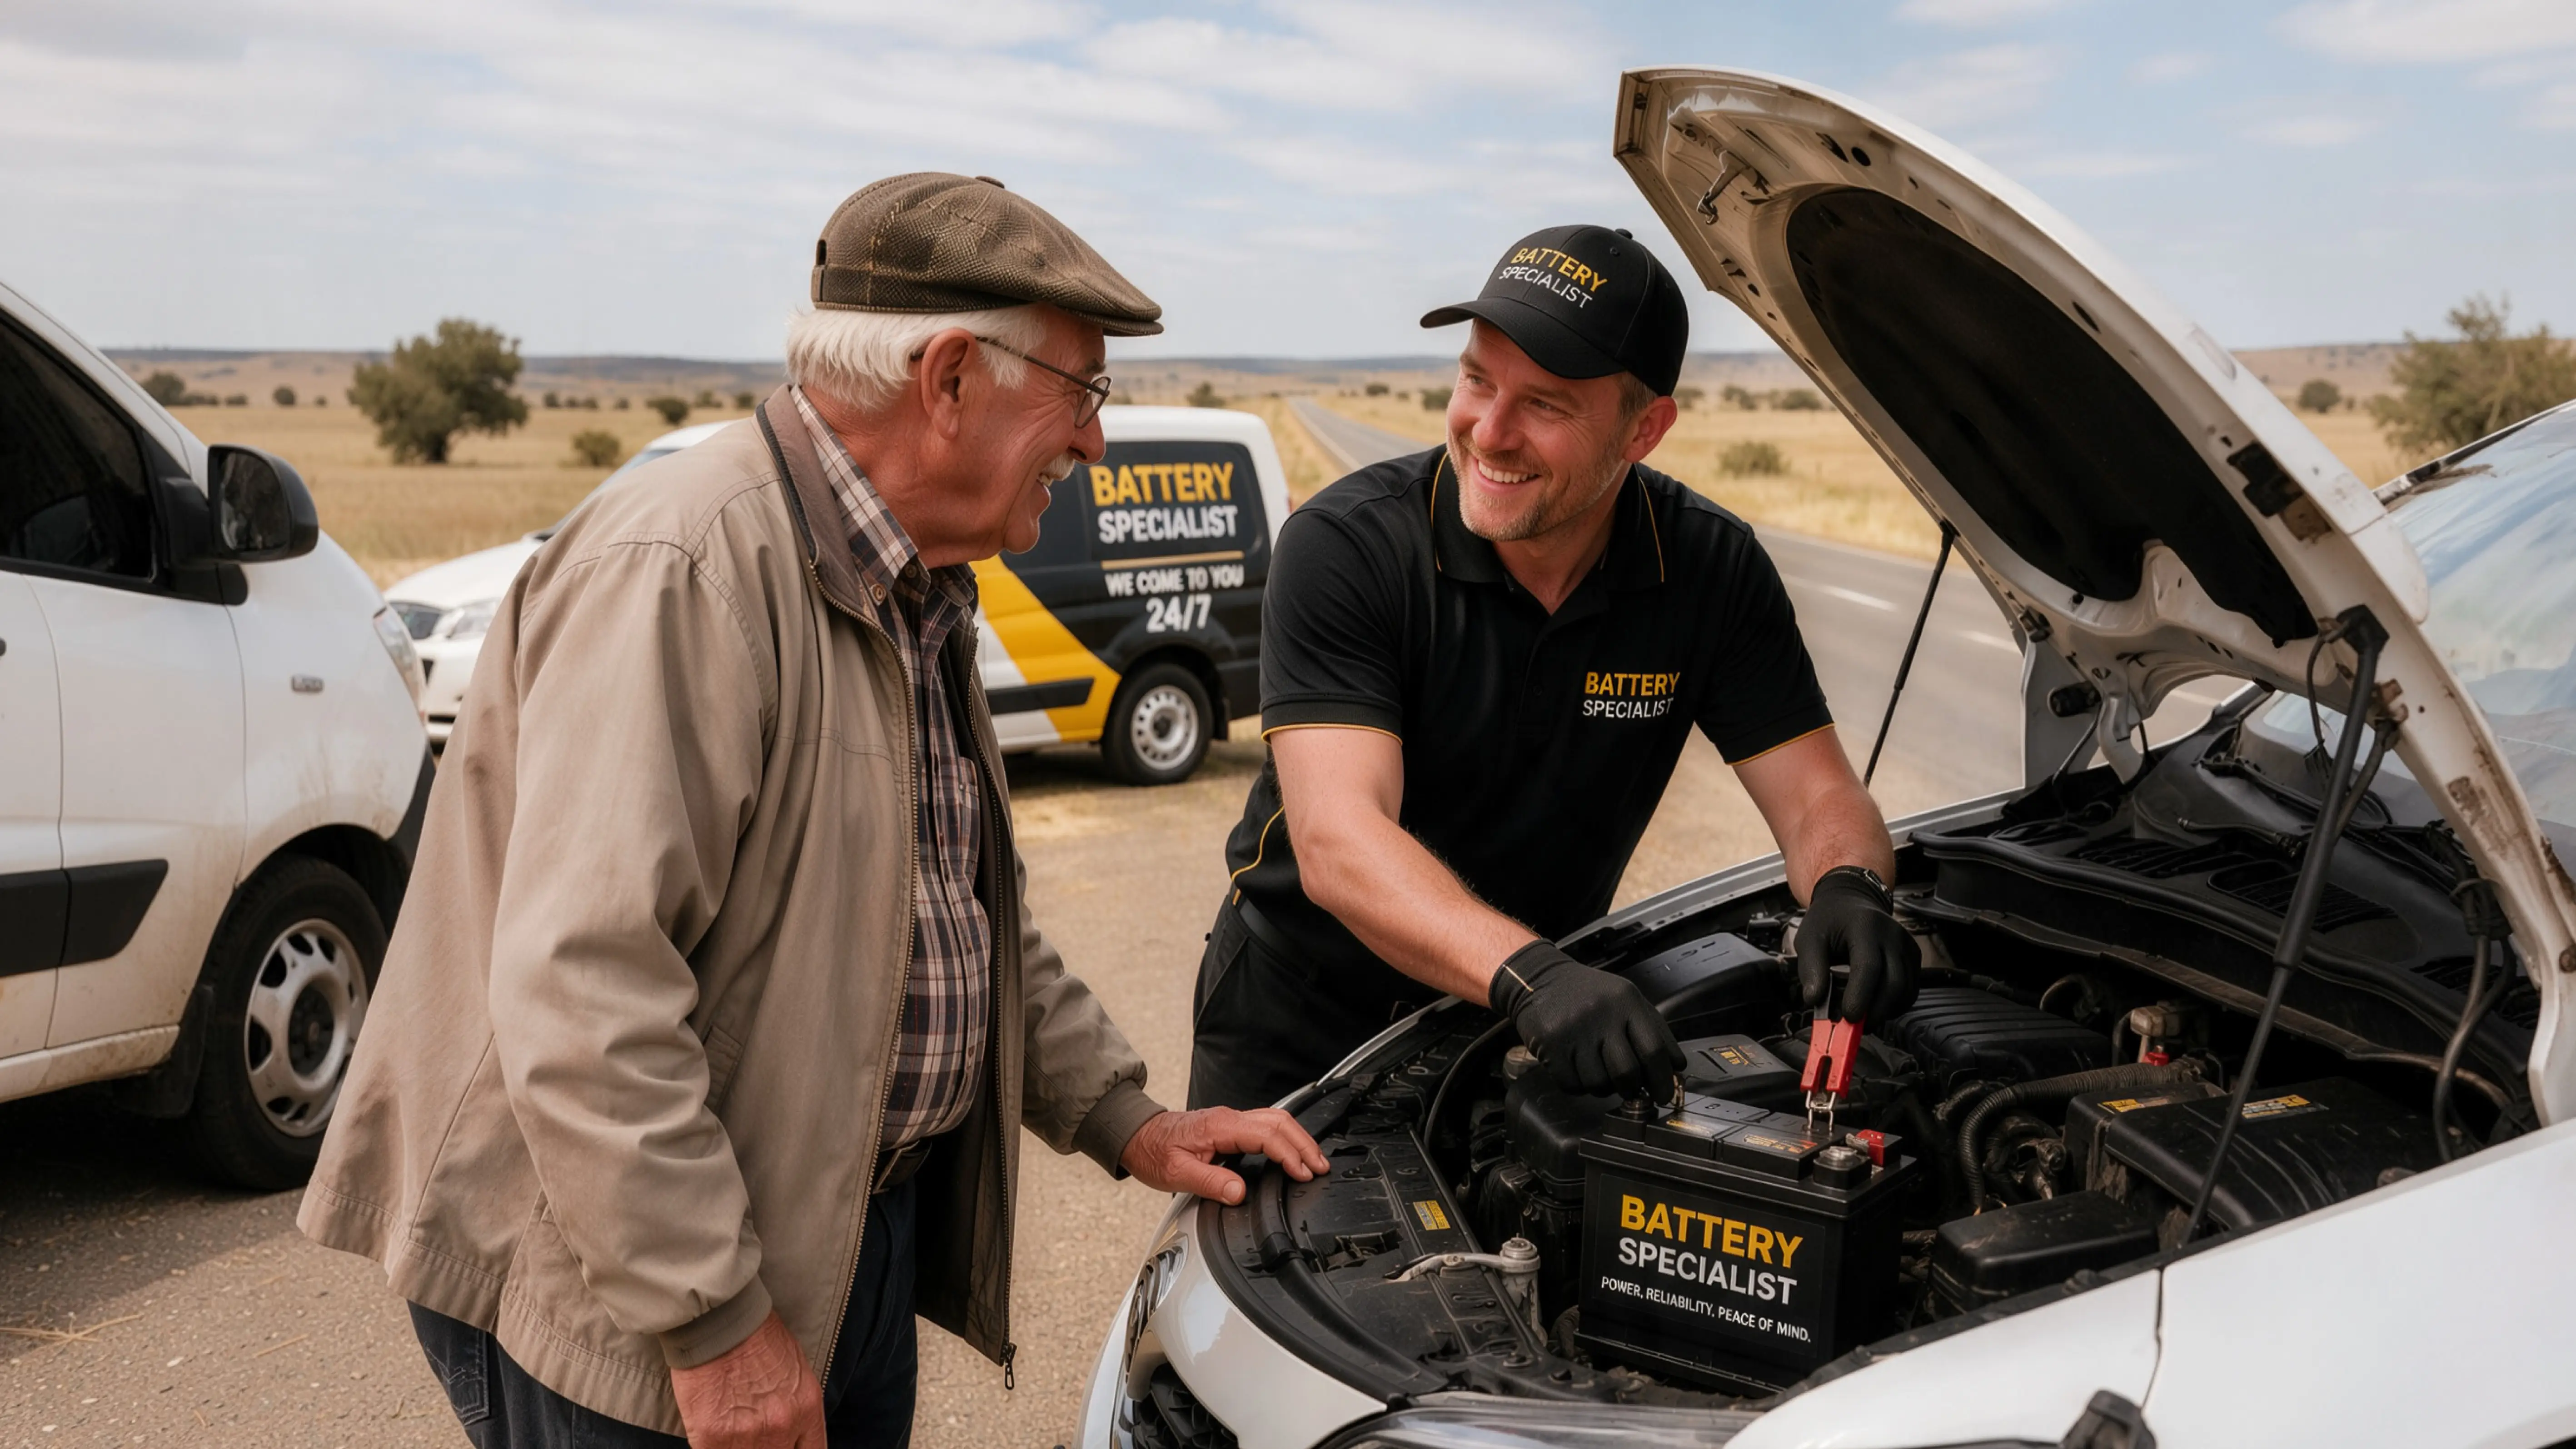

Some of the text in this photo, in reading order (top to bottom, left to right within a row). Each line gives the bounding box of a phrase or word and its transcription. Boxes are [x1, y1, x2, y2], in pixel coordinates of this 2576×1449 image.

[1499, 266, 1593, 309] SPECIALIST
[1510, 247, 1608, 292] BATTERY
[1090, 462, 1234, 506] BATTERY
[1098, 505, 1238, 544] SPECIALIST
[1105, 564, 1244, 597] WE COME TO YOU
[1146, 594, 1212, 633] 24/7
[1584, 672, 1680, 696] BATTERY
[1582, 697, 1674, 719] SPECIALIST
[1620, 1194, 1803, 1268] BATTERY
[1619, 1237, 1797, 1305] SPECIALIST
[1718, 1306, 1755, 1328] PEACE
[1758, 1317, 1774, 1332] OF
[1777, 1321, 1811, 1343] MIND.
